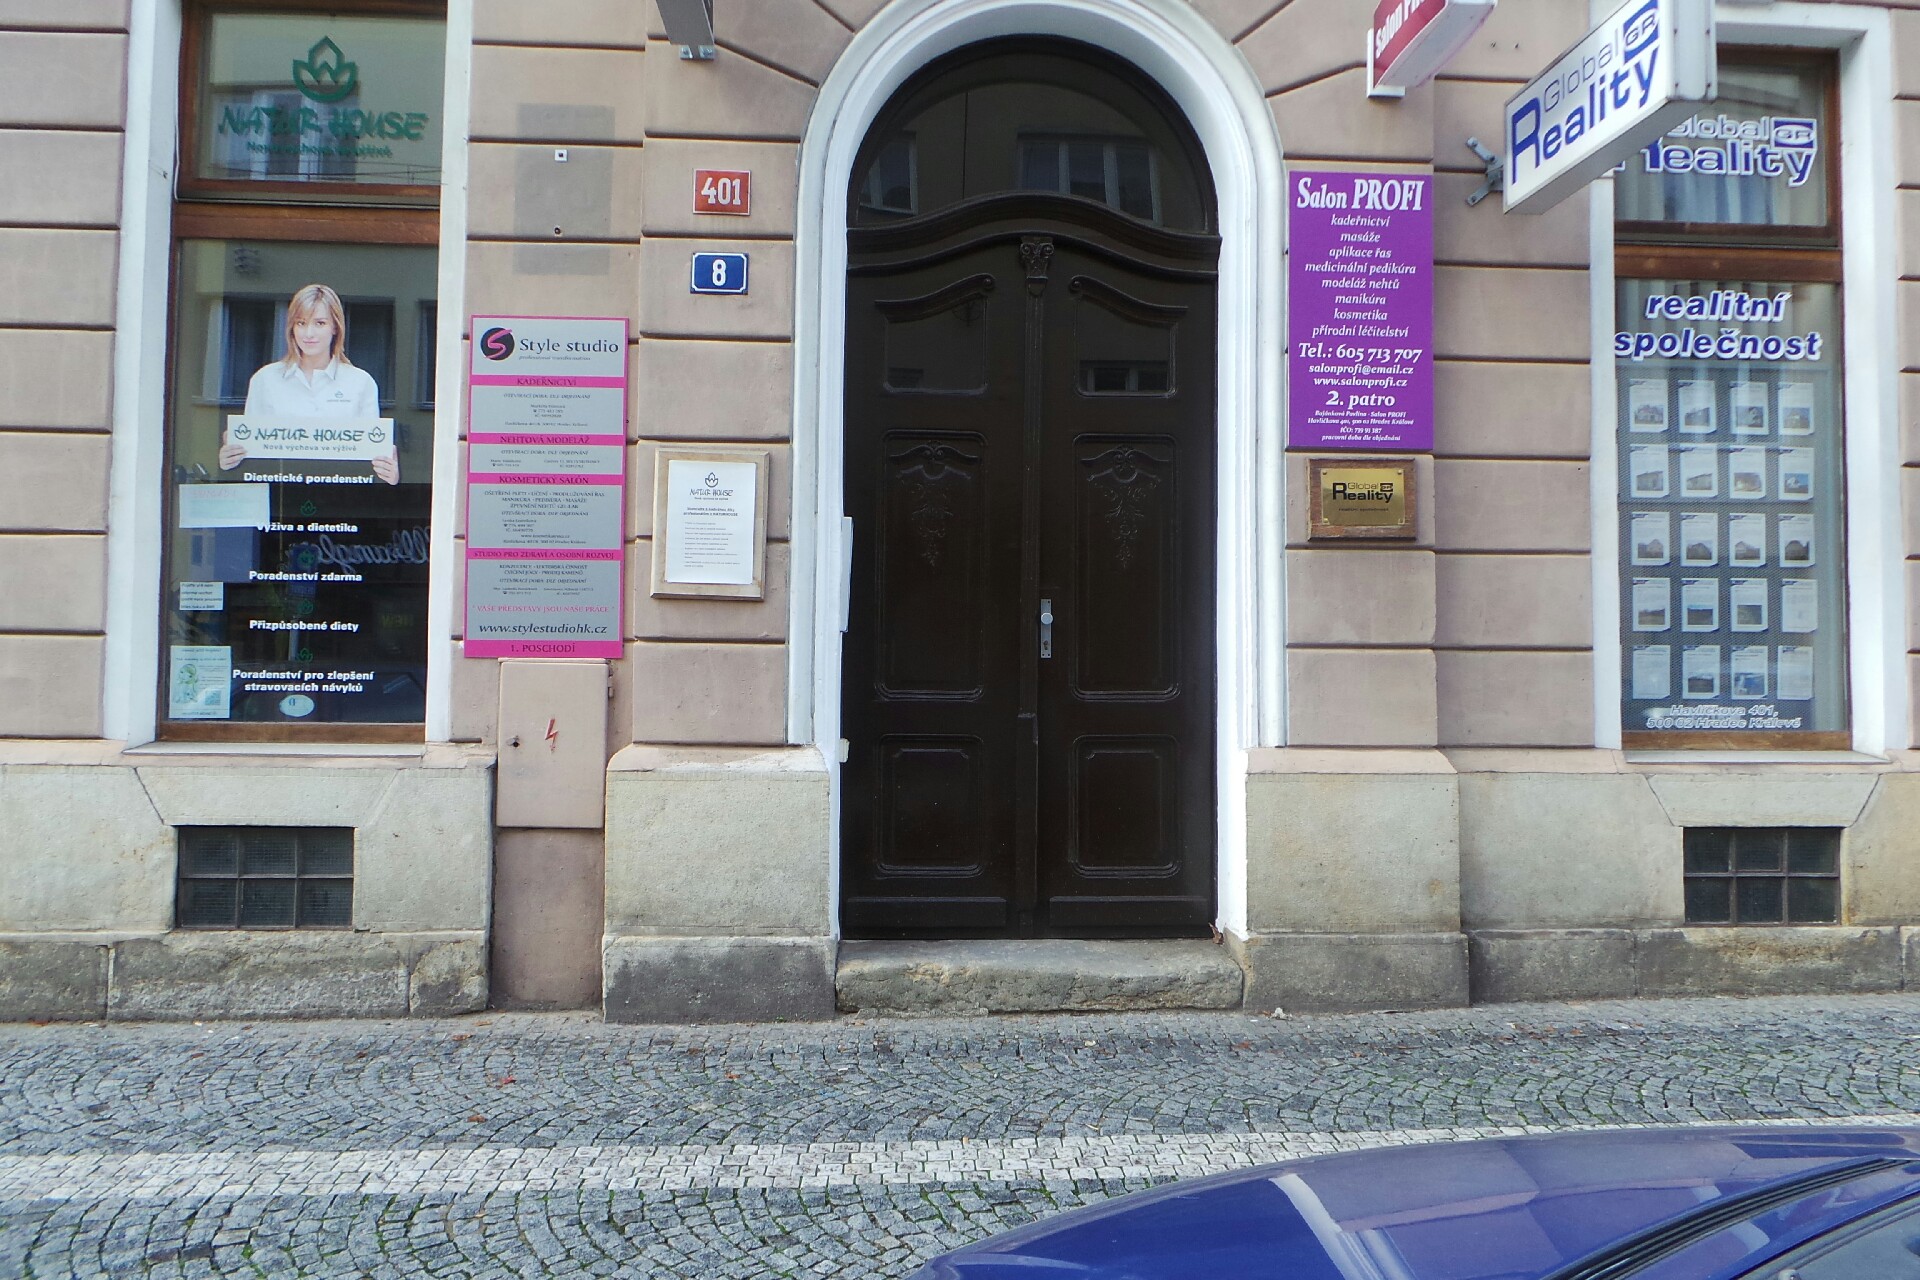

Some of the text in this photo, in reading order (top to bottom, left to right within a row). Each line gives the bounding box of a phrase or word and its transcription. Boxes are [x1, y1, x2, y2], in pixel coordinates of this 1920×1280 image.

[1543, 28, 1619, 113] Global
[1511, 45, 1661, 185] Reality
[217, 105, 430, 141] NATUR HOUSE
[701, 177, 741, 206] 401
[1296, 177, 1425, 210] Salon PROFI
[1331, 214, 1391, 227] kadeřnictví
[1340, 231, 1380, 243] masáže
[1329, 246, 1392, 259] aplikace řas
[712, 259, 727, 286] 8
[1305, 261, 1416, 275] medicinální pedikúra
[1322, 277, 1400, 289] modeláž nehtů
[1335, 293, 1386, 305] manikúra
[1645, 289, 1792, 322] realitní
[1334, 308, 1388, 320] kosmetika
[1312, 325, 1409, 338] přírodní léčitelství
[519, 338, 619, 355] Style studio
[1615, 327, 1823, 361] společnost
[1299, 342, 1423, 363] Tel.: 605 713 707
[1308, 363, 1414, 376] salonprofi@email.cz
[516, 376, 577, 386] KADEŘNICTVÍ
[1314, 376, 1408, 388] www.salonprofi.cz
[1325, 390, 1396, 410] 2. patro
[254, 428, 365, 442] NATUR HOUSE
[500, 436, 590, 444] NEHTOVÁ MODELÁŽ
[285, 444, 319, 452] výchova
[243, 472, 374, 485] Dietetické poradenství
[499, 475, 589, 485] KOSMETICKÝ SALÓN
[1332, 482, 1394, 503] Reality
[1347, 482, 1379, 490] Global
[307, 522, 358, 532] dietetika
[249, 571, 362, 582] Poradenství zdarma
[249, 619, 359, 633] Přizpůsobené diety
[479, 623, 608, 635] www.stylestudiohk.cz
[511, 642, 576, 653] 1. POSCHODÍ
[232, 669, 301, 680] Poradenství
[304, 672, 324, 681] pro
[327, 670, 374, 681] zlepšení
[244, 682, 363, 693] stravovacích návyků
[1669, 704, 1779, 717] Havlíčkova 401,
[1646, 716, 1802, 730] 500 02 Hradec Králové
